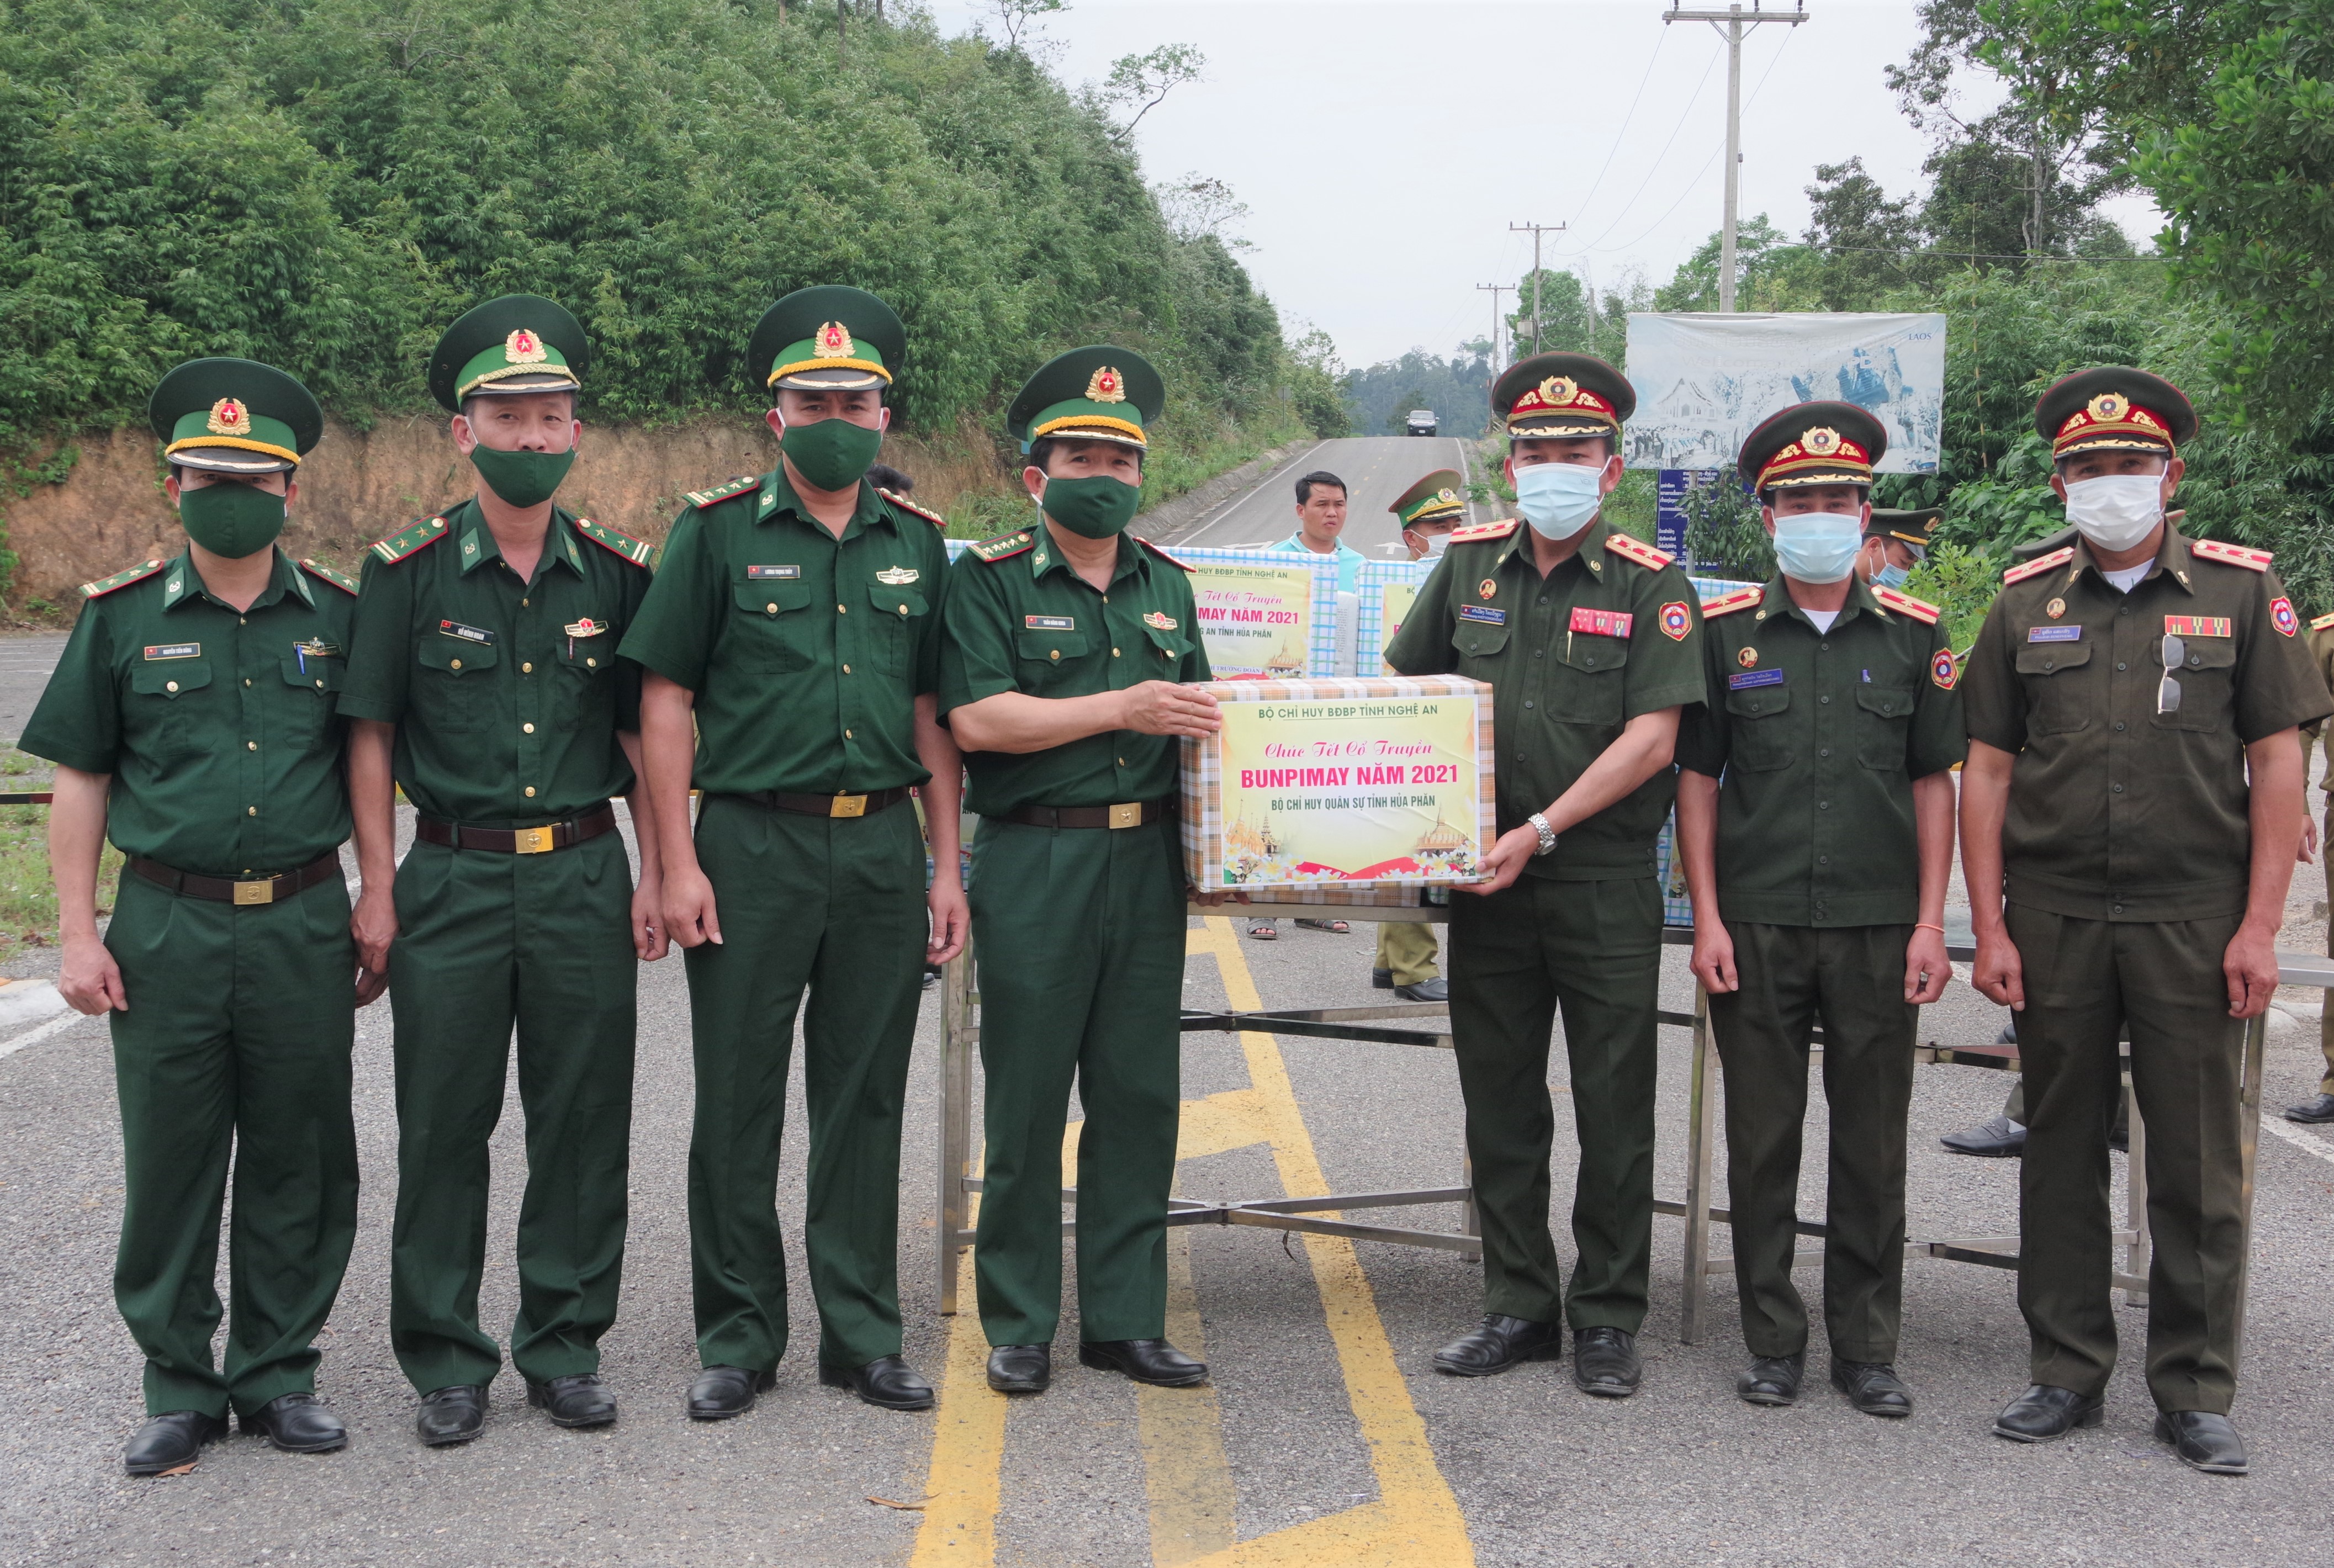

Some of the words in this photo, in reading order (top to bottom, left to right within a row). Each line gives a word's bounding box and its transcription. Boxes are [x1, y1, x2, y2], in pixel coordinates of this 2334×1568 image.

[1848, 356, 1890, 369] PDR
[1236, 567, 1252, 577] TỈNH
[1255, 570, 1275, 580] NGHỆ
[1204, 590, 1221, 602] Tết
[1225, 591, 1240, 602] Cổ
[1231, 607, 1263, 623] NĂM
[1267, 611, 1298, 624] 2021
[1218, 626, 1234, 636] TỈNH
[1236, 627, 1250, 637] HỦA
[1259, 706, 1274, 721] BỘ
[1278, 704, 1298, 718] CHỈ
[1302, 707, 1324, 718] HUY
[1327, 707, 1356, 717] BĐBP
[1359, 703, 1384, 716] TỈNH
[1388, 702, 1419, 718] NGHỆ
[1422, 704, 1438, 714] AN
[1264, 743, 1305, 759] Chúc
[1312, 741, 1340, 757] Tết
[1346, 740, 1368, 756] Cổ
[1374, 739, 1432, 758] Truyền
[1241, 767, 1350, 788] BUNPIMAY
[1357, 762, 1404, 785] NĂM
[1411, 764, 1457, 784] 2021
[1272, 797, 1284, 813] BỘ
[1287, 795, 1302, 811] CHỈ
[1304, 798, 1322, 810] HUY
[1325, 796, 1349, 811] QUÂN
[1352, 796, 1366, 811] SỰ
[1367, 793, 1388, 808] TỈNH
[1390, 792, 1409, 808] HỦA
[1411, 793, 1435, 807] PHĂN
